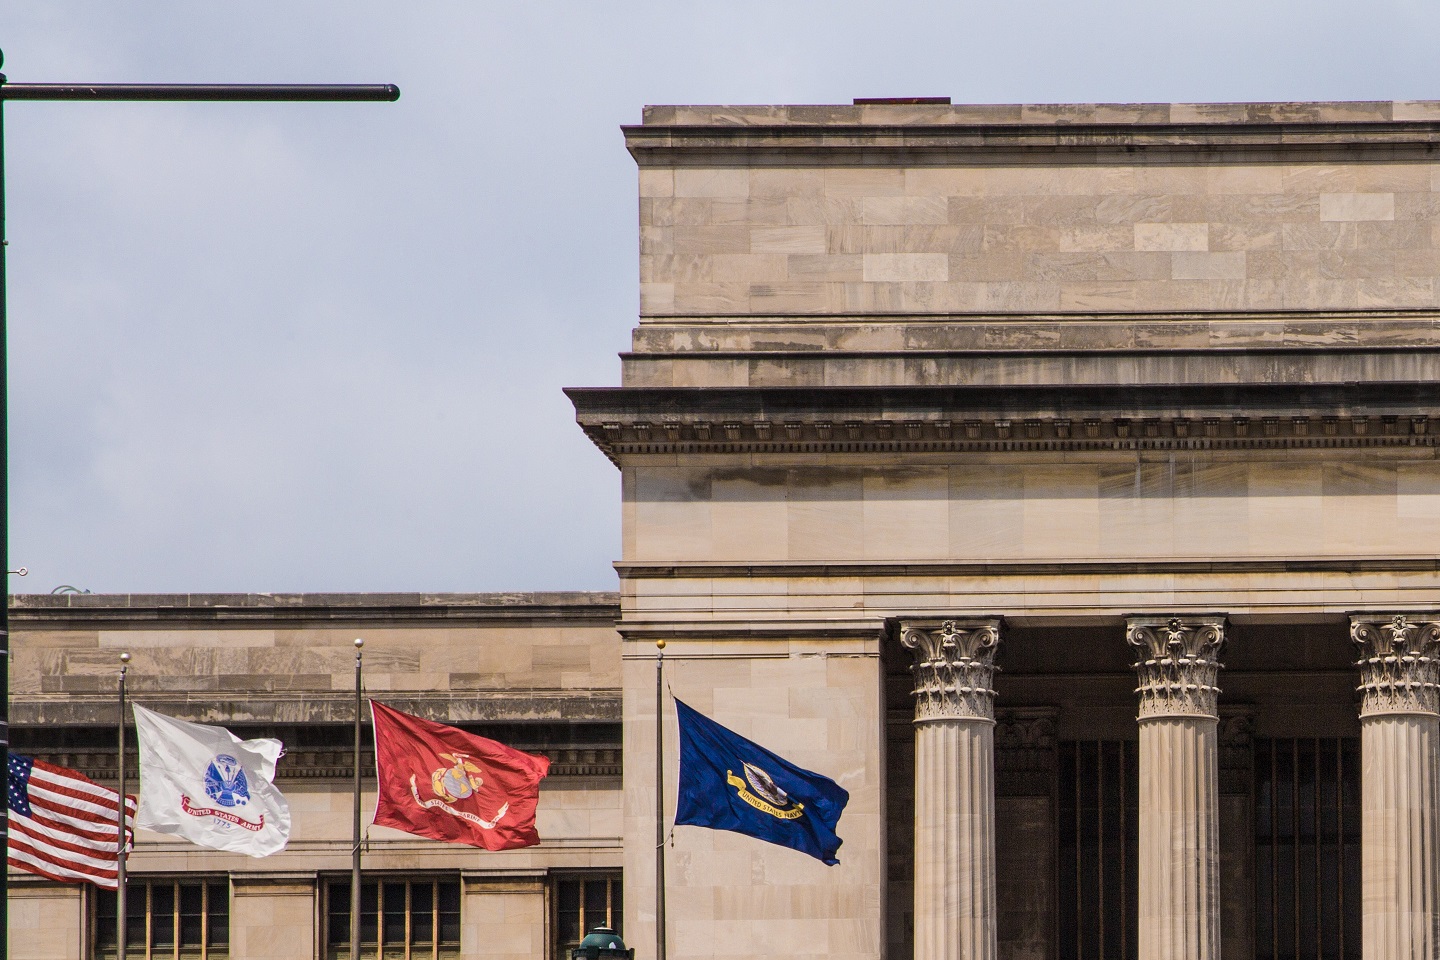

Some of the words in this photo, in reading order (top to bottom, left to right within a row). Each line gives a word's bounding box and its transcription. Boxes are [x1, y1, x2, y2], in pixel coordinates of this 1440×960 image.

[742, 791, 762, 808] UNITED
[763, 804, 783, 818] STATES
[785, 810, 802, 818] NAVY
[187, 807, 211, 816] UNITED
[214, 810, 239, 823] STATES
[241, 821, 261, 832] ARMY
[213, 817, 231, 829] 1775
